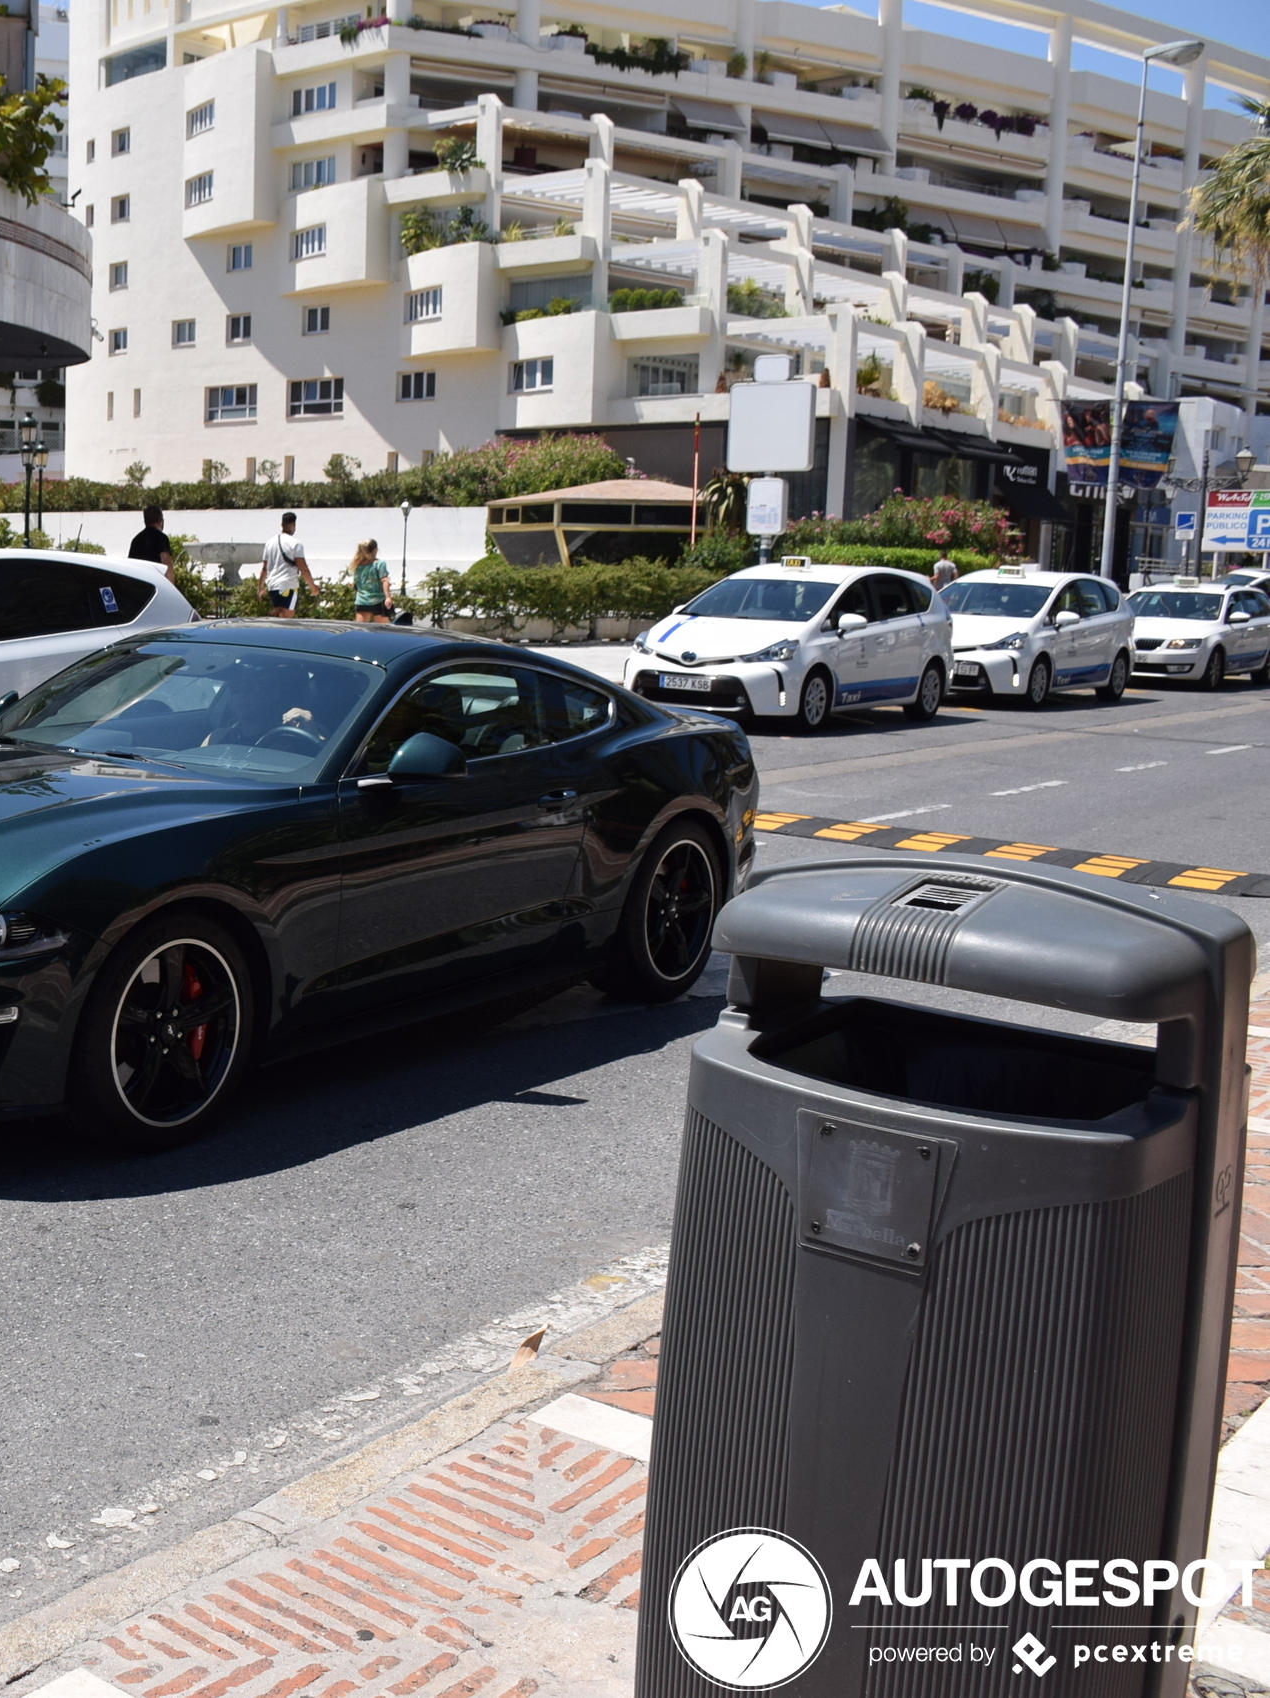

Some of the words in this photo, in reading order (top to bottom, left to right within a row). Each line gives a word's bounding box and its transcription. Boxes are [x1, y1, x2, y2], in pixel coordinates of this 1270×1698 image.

[1206, 512, 1248, 520] PARKING
[1206, 521, 1248, 530] PÚBLICO
[786, 558, 801, 567] TAXI
[666, 675, 689, 688] 2537
[691, 677, 710, 690] KSB
[841, 690, 862, 704] Taxi
[824, 1209, 906, 1247] Marbella
